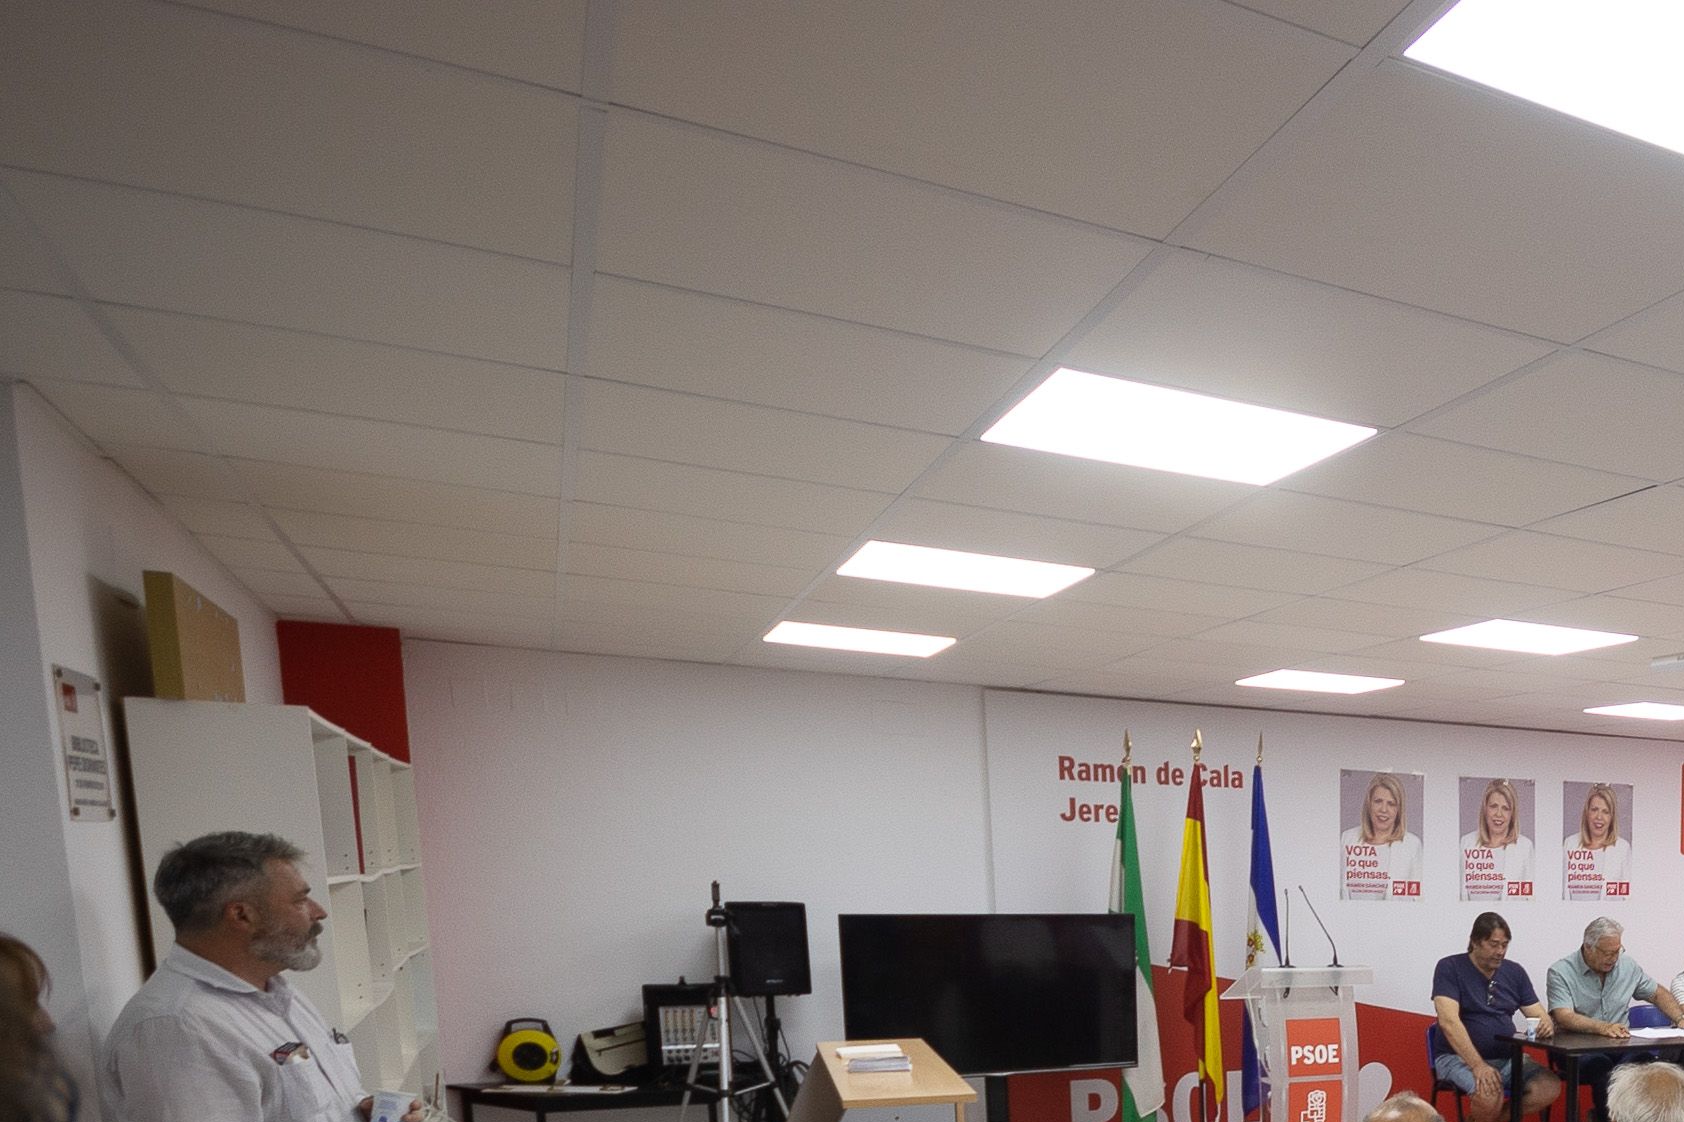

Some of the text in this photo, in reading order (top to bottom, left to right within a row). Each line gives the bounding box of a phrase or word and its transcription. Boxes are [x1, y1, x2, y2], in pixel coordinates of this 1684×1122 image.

[1156, 761, 1184, 786] de
[1060, 797, 1119, 823] Jere
[1345, 845, 1377, 857] VOTA
[1464, 849, 1493, 859] VOTA
[1567, 850, 1594, 861] VOTA
[1346, 857, 1378, 869] lo que
[1465, 860, 1494, 871] lo que
[1567, 861, 1595, 872] lo que
[1346, 868, 1391, 881] piensas.
[1465, 871, 1506, 882] piensas.
[1567, 871, 1605, 882] piensas.
[1291, 1044, 1339, 1065] PSOE
